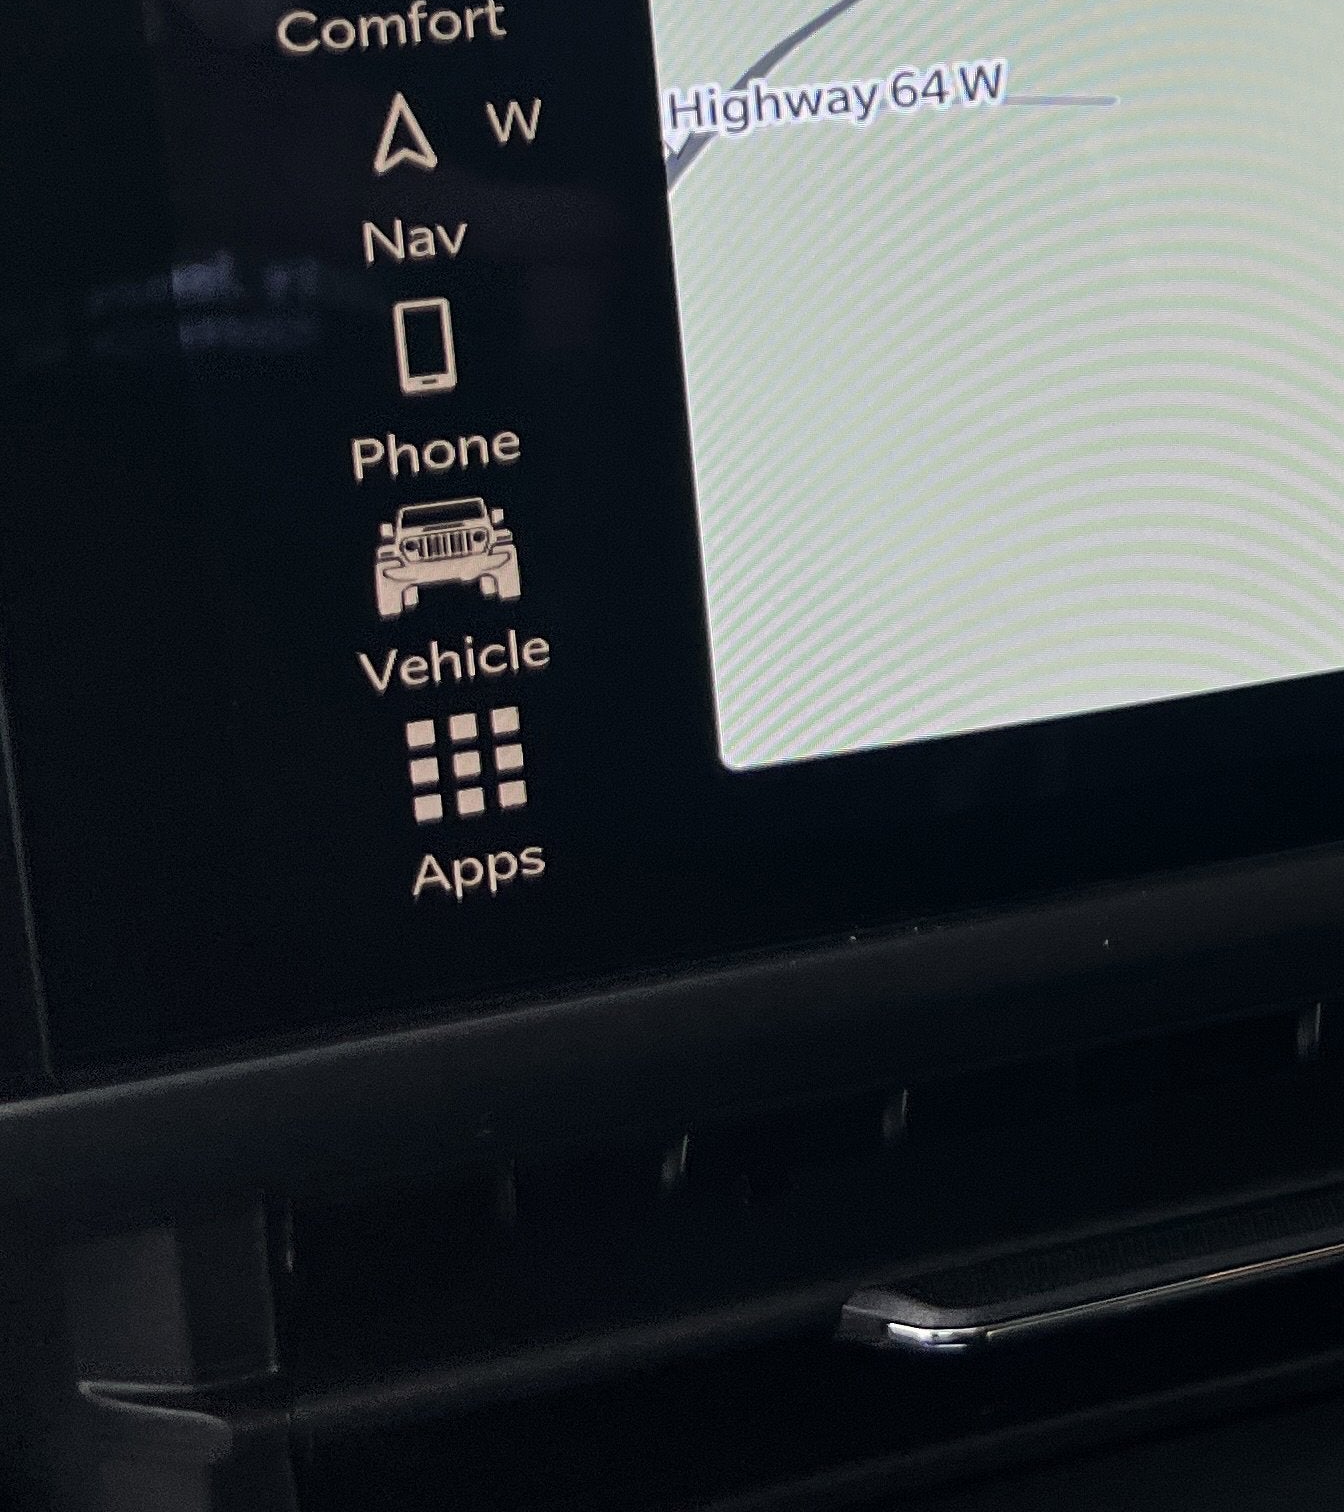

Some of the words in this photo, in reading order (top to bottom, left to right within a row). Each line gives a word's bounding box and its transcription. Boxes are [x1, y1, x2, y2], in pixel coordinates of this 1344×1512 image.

[486, 98, 542, 144] W
[668, 83, 878, 134] Highway
[890, 70, 949, 108] 64
[958, 63, 1004, 102] W
[362, 218, 468, 266] Nav
[351, 431, 521, 483] Phone
[357, 628, 551, 695] Vehicle
[412, 845, 547, 903] Apps
